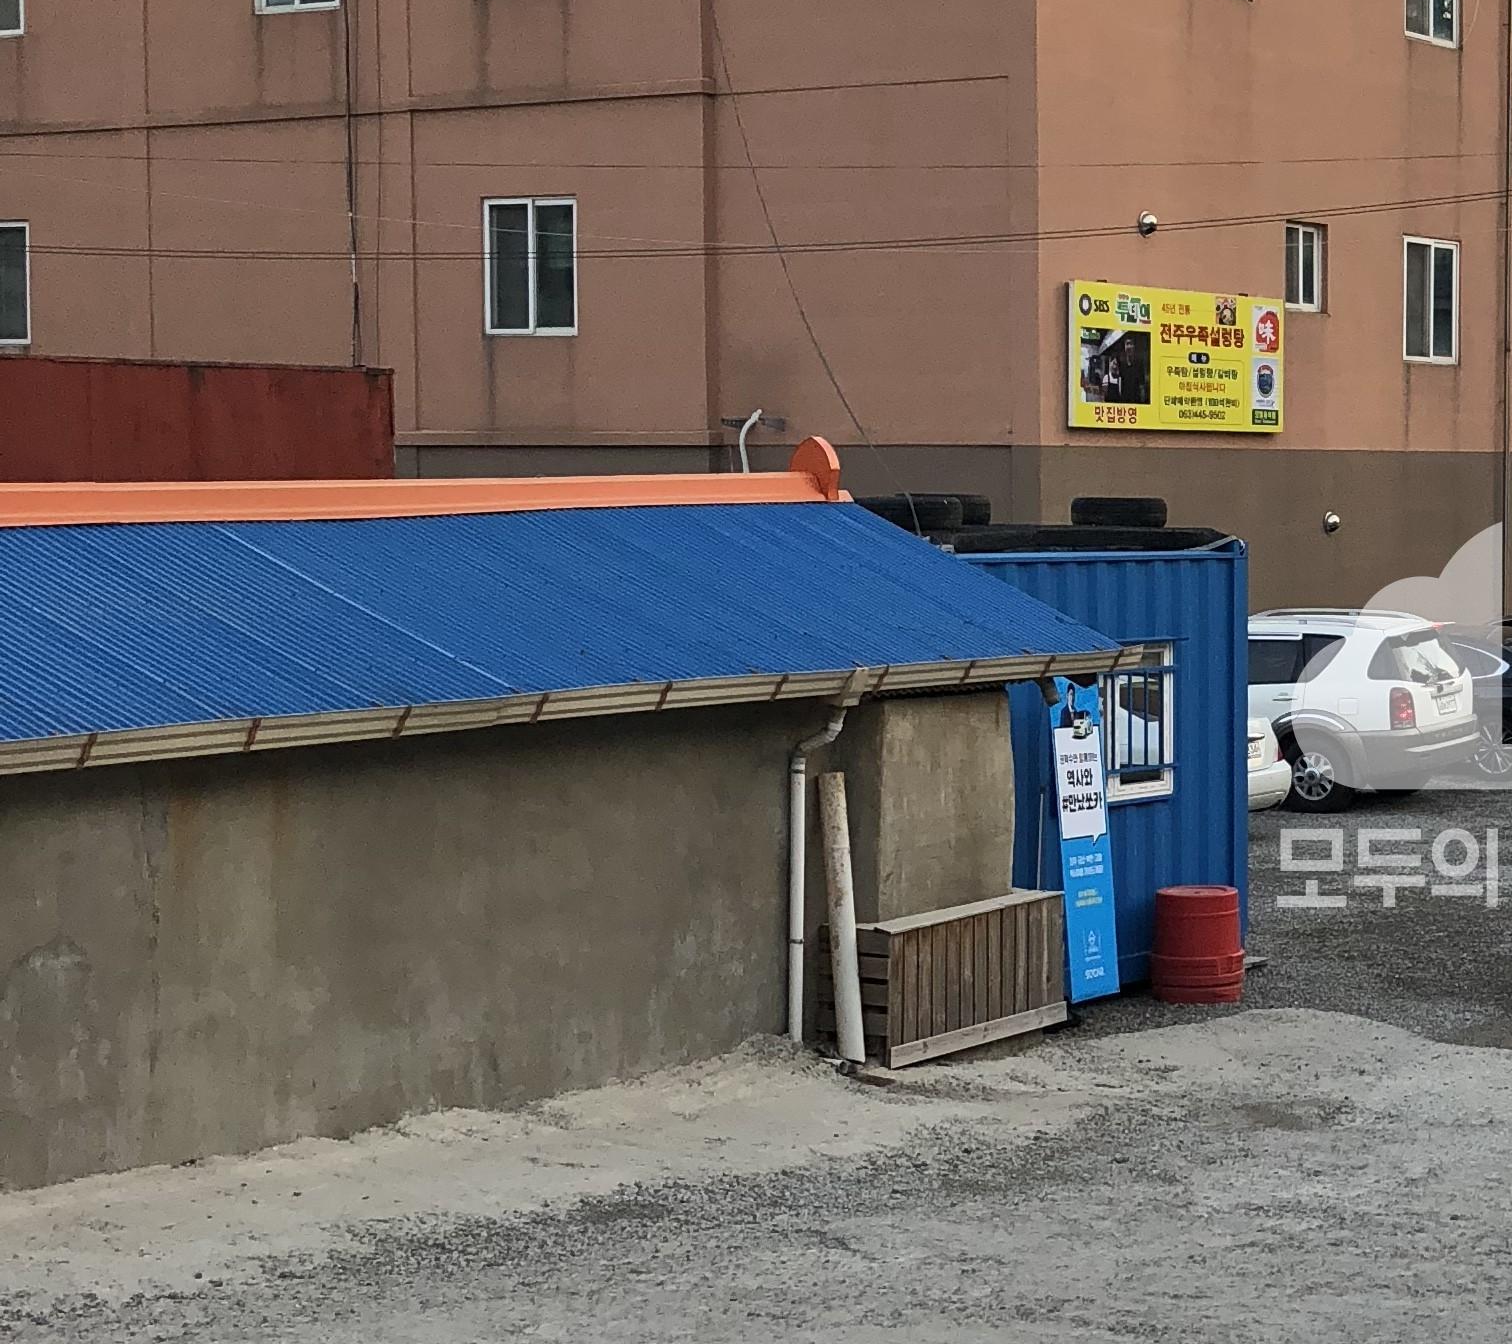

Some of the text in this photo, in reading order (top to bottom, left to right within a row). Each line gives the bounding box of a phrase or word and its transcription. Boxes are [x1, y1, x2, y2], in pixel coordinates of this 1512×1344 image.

[1094, 299, 1110, 313] SBS
[1160, 322, 1245, 349] 전주우족설렁탕
[1258, 319, 1277, 345] 味
[1094, 406, 1138, 424] 맛집방영
[1066, 768, 1093, 788] 역사와
